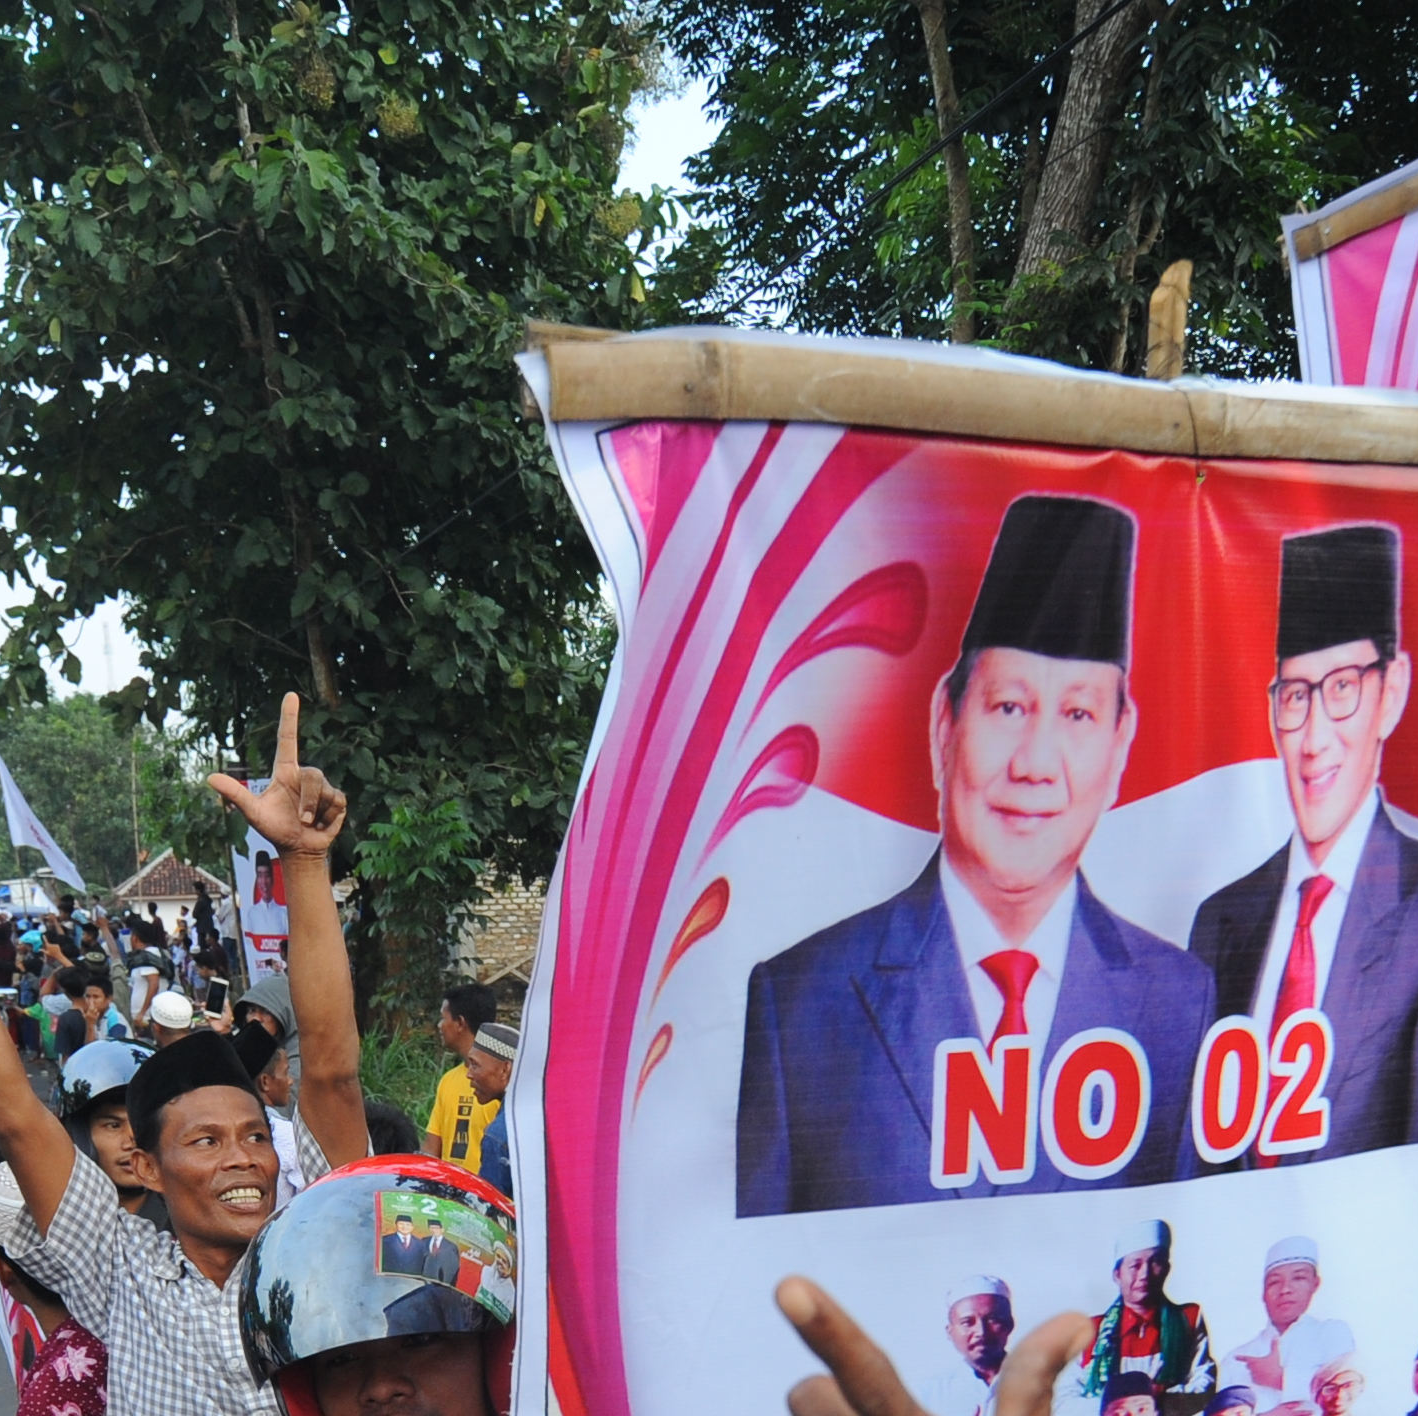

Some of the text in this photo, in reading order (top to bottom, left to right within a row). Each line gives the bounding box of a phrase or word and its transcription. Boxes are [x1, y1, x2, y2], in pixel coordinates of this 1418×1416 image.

[939, 1018, 1329, 1180] NO 02
[421, 1198, 439, 1217] 2
